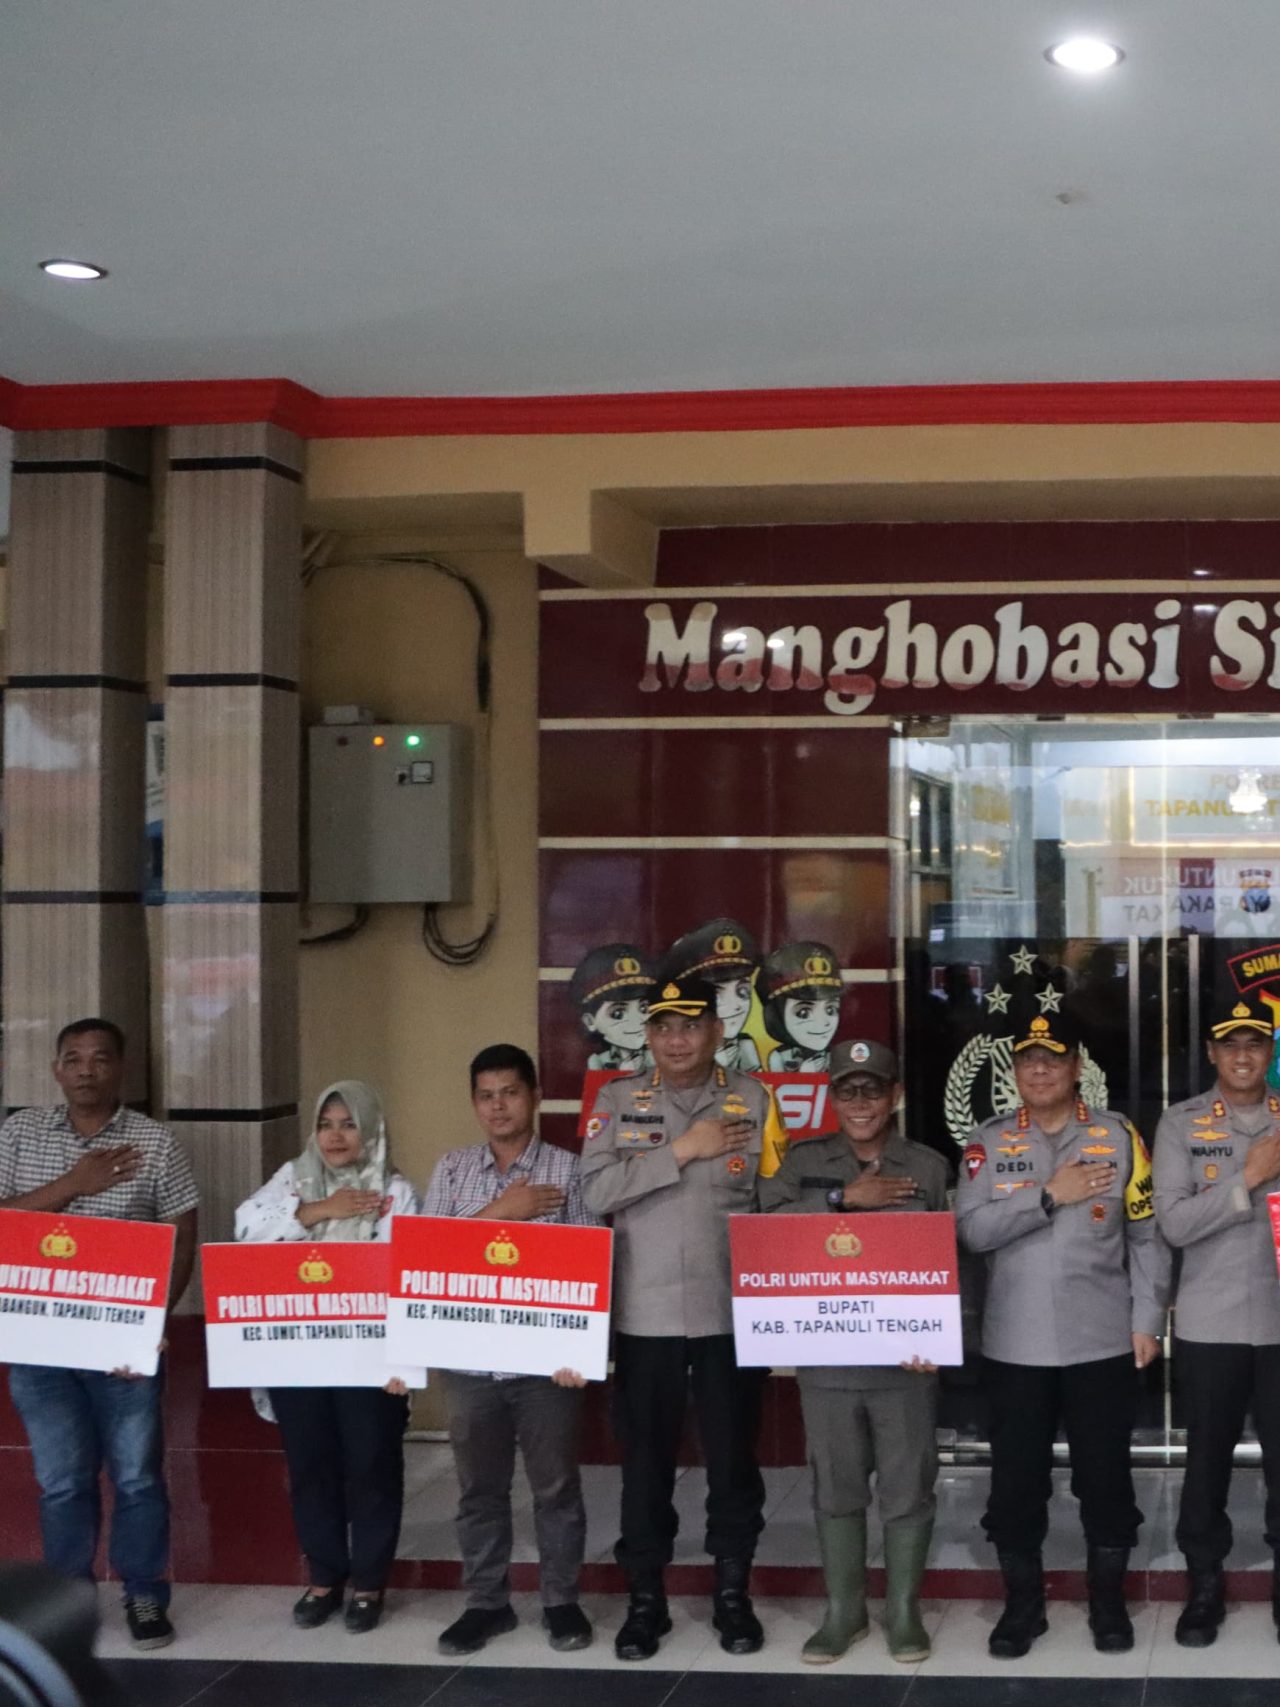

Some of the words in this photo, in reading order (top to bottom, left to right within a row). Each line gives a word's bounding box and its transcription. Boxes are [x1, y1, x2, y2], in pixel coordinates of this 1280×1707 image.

[638, 600, 1182, 714] Manghobasi
[1190, 1146, 1233, 1157] WAHYU
[996, 1162, 1034, 1173] DEDI
[53, 1269, 157, 1301] MASYARAKAT
[401, 1270, 444, 1295] POLRI
[447, 1272, 498, 1298] UNTUK
[500, 1276, 598, 1306] MASYARAKAT
[740, 1273, 785, 1287] POLRI
[789, 1272, 842, 1286] UNTUK
[846, 1270, 949, 1285] MASYARAKAT
[52, 1302, 101, 1321] TAPANULI
[105, 1306, 146, 1325] TENGAH
[218, 1295, 263, 1318] POLRI
[265, 1293, 317, 1317] UNTUK
[318, 1292, 387, 1316] MASYARA
[818, 1301, 875, 1314] BUPATI
[406, 1303, 428, 1319] KEC.
[500, 1309, 547, 1328] TAPANULI
[550, 1312, 588, 1330] TENGAH
[752, 1320, 789, 1334] KAB.
[794, 1319, 871, 1333] TAPANULI
[878, 1319, 943, 1332] TENGAH
[243, 1326, 265, 1341] KEC.
[306, 1324, 353, 1340] TAPANULI
[356, 1324, 386, 1338] TENGA
